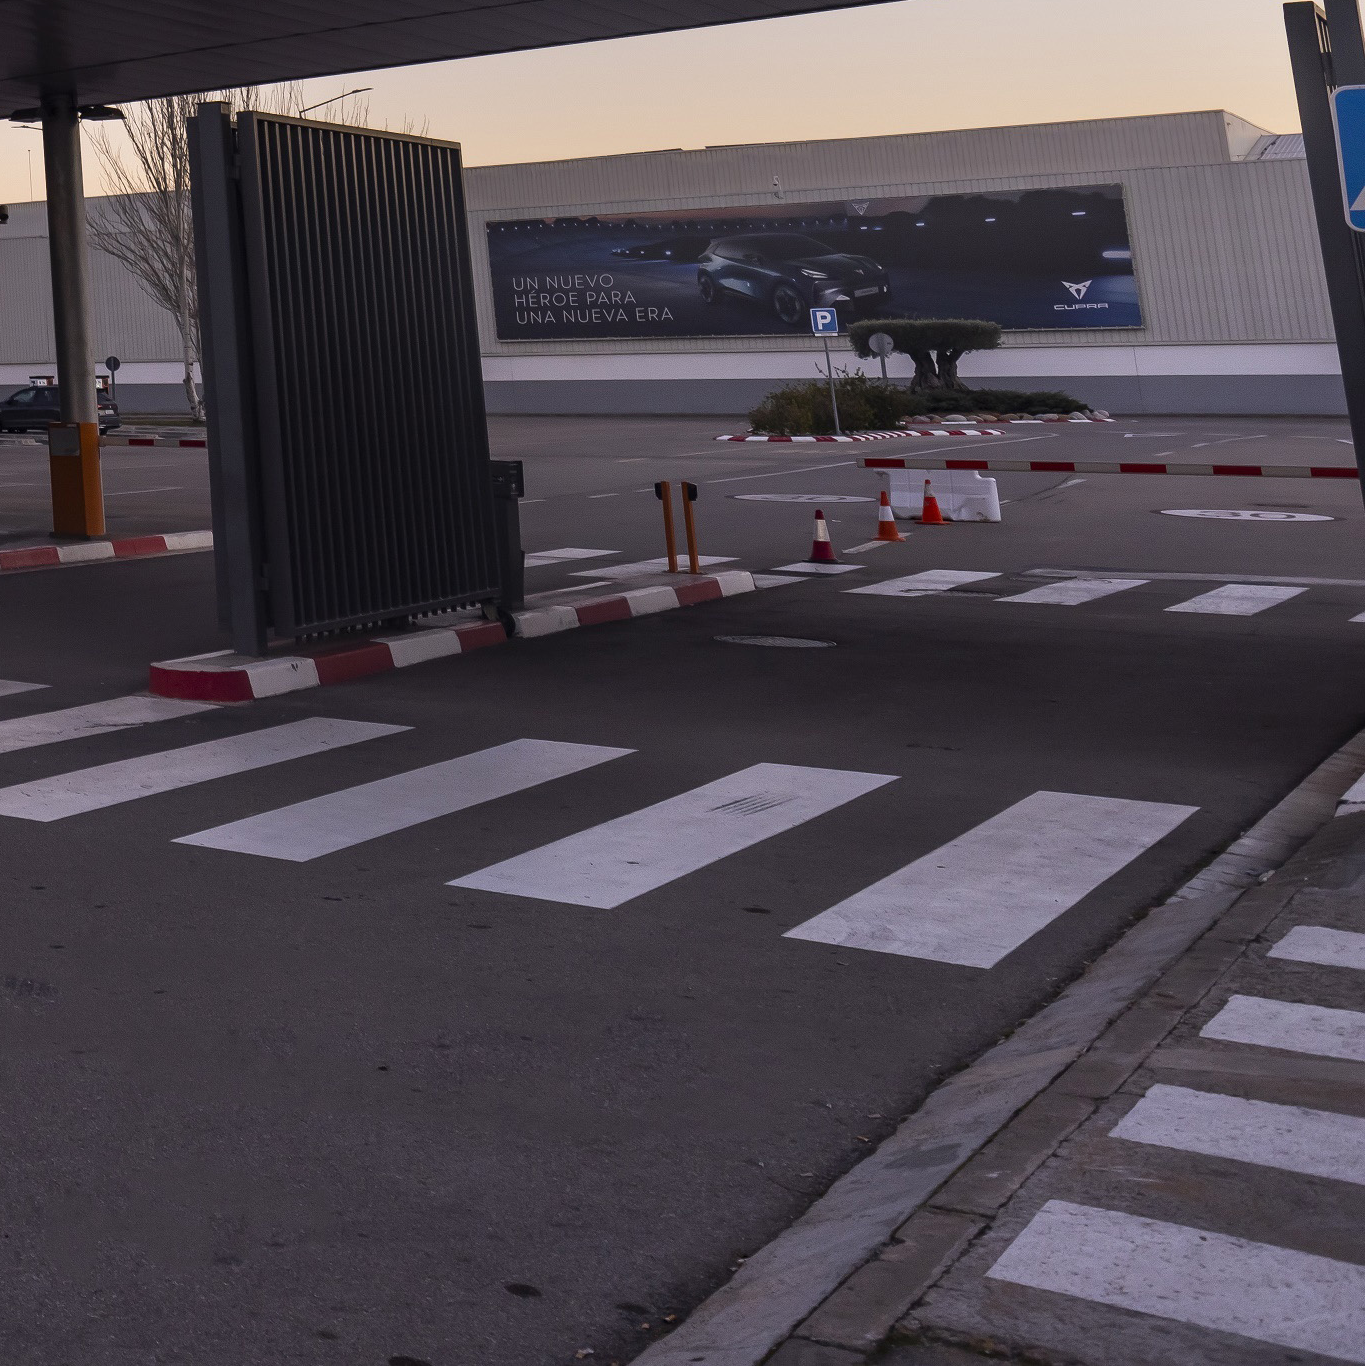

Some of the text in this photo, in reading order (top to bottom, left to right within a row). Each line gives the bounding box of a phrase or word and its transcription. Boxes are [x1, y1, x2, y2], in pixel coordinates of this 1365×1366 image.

[512, 273, 614, 291] UN NUEVO
[514, 290, 637, 308] HÉROE PARA
[1053, 302, 1109, 310] CUPRA
[516, 307, 674, 325] UNA NUEVA ERA
[815, 311, 832, 330] P
